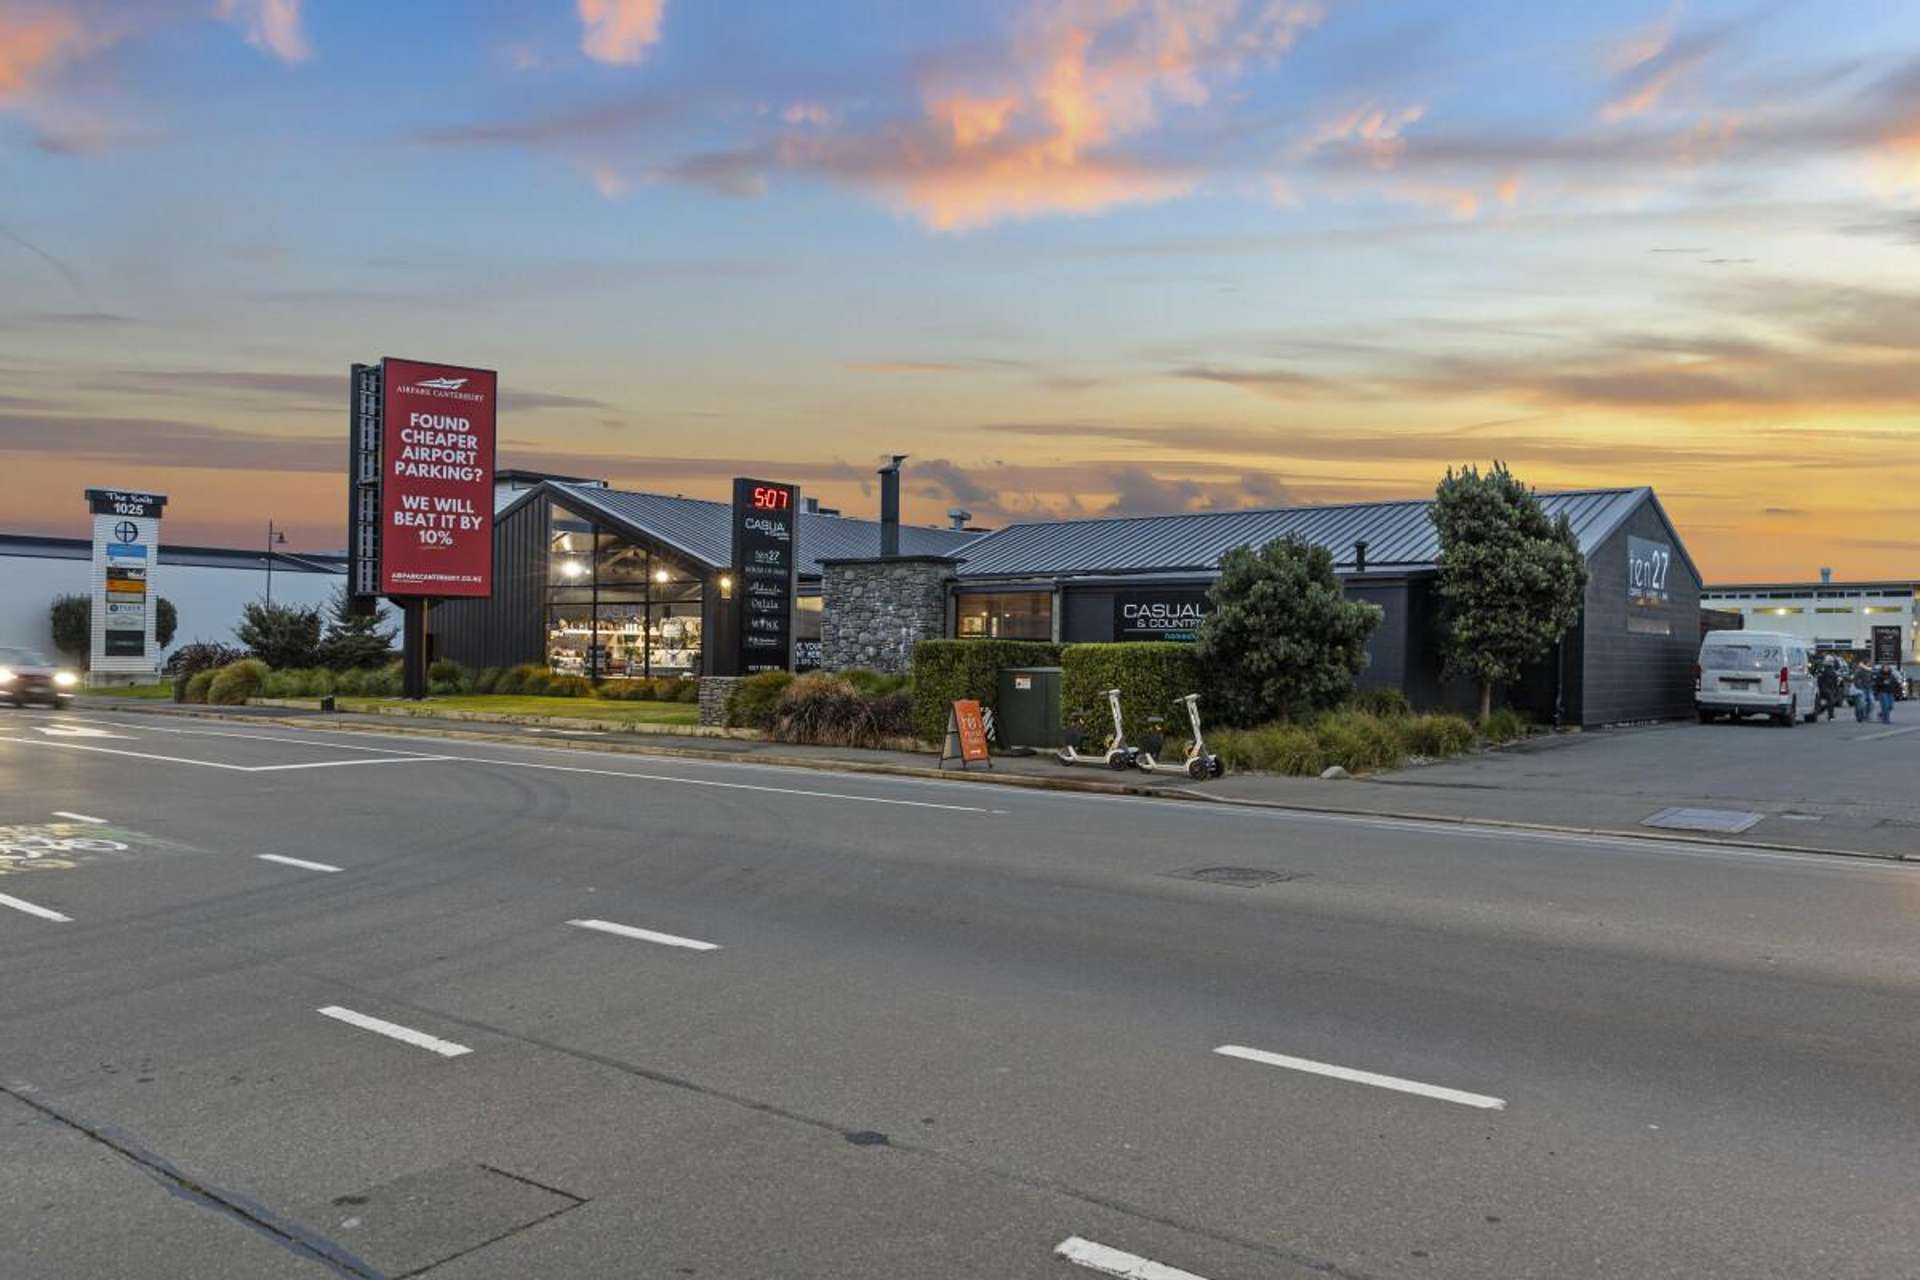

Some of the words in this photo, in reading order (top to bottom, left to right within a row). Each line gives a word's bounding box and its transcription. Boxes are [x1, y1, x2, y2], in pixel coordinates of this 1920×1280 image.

[397, 386, 430, 396] AIRPARK
[433, 389, 484, 402] CANTERBURY
[410, 412, 470, 432] FOUND
[401, 429, 477, 449] CHEAPER
[402, 446, 477, 465] AIRPORT
[395, 461, 483, 482] PARKING?
[114, 503, 144, 515] 1025
[402, 495, 430, 510] WE
[433, 497, 474, 513] WILL
[394, 511, 437, 527] BEAT
[441, 514, 457, 528] IT
[460, 515, 483, 530] BY
[419, 530, 453, 545] 10%
[1124, 603, 1206, 618] CASUAL
[1137, 619, 1146, 628] &
